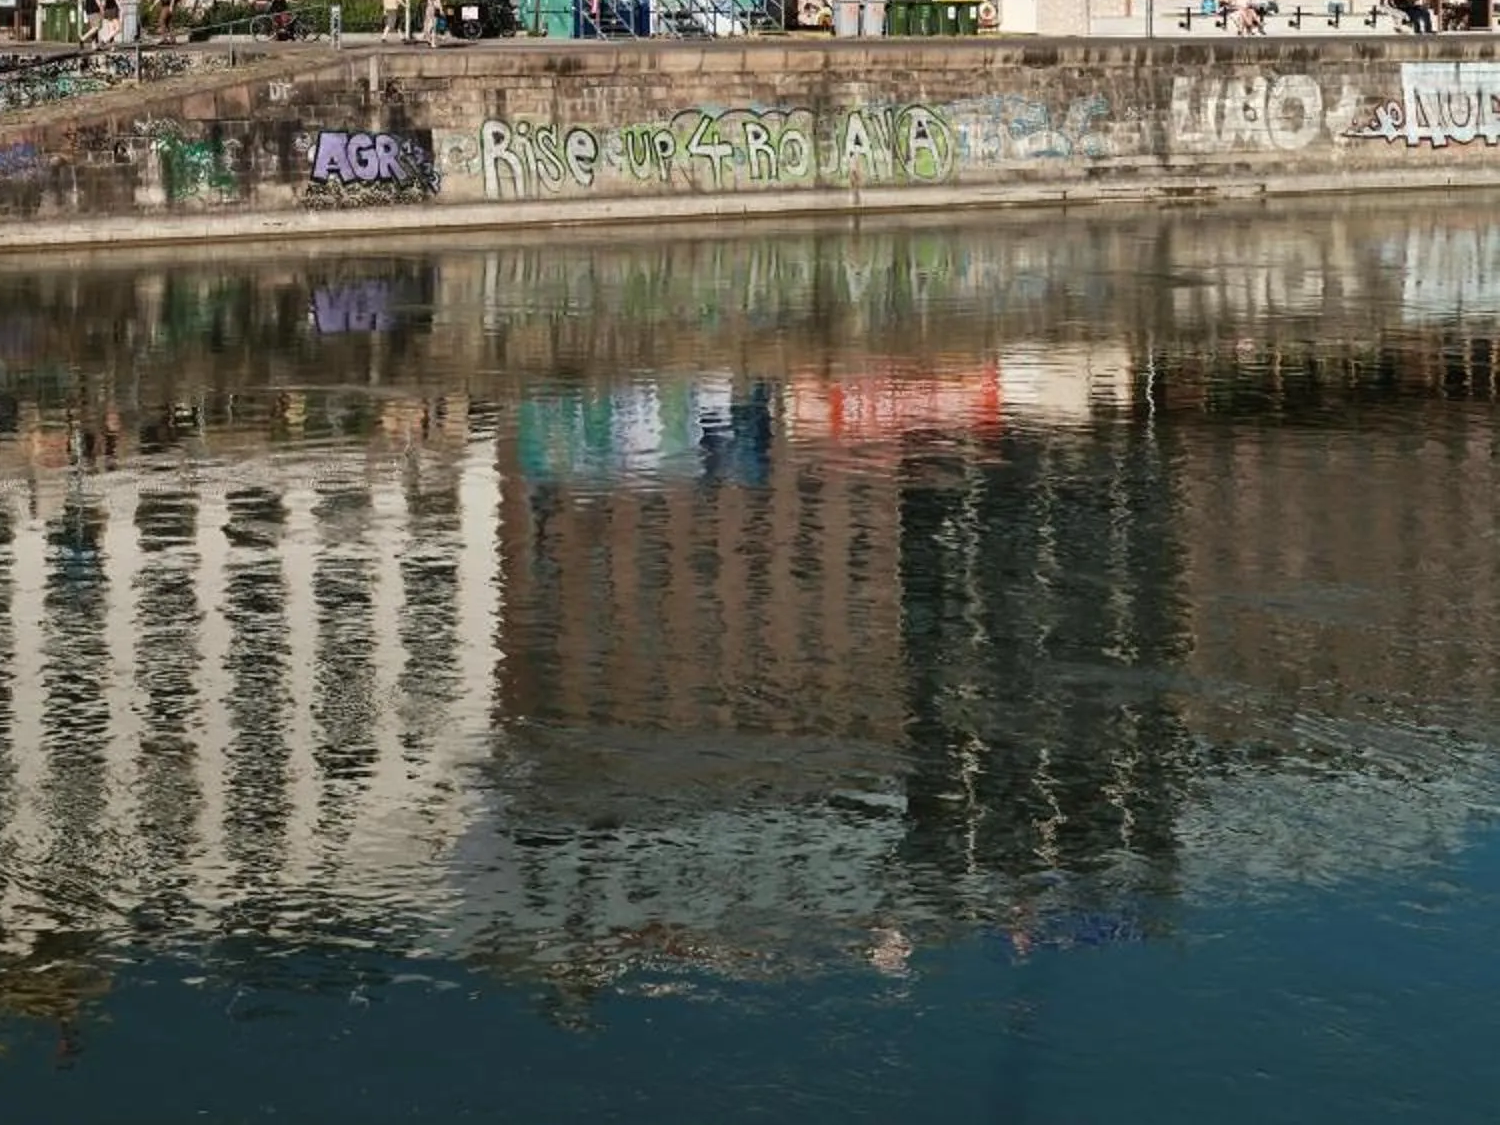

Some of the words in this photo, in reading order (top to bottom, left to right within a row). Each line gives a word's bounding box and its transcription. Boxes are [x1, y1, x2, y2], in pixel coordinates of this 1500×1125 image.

[312, 128, 407, 184] AGR
[625, 127, 677, 183] UP
[686, 112, 735, 187] 4
